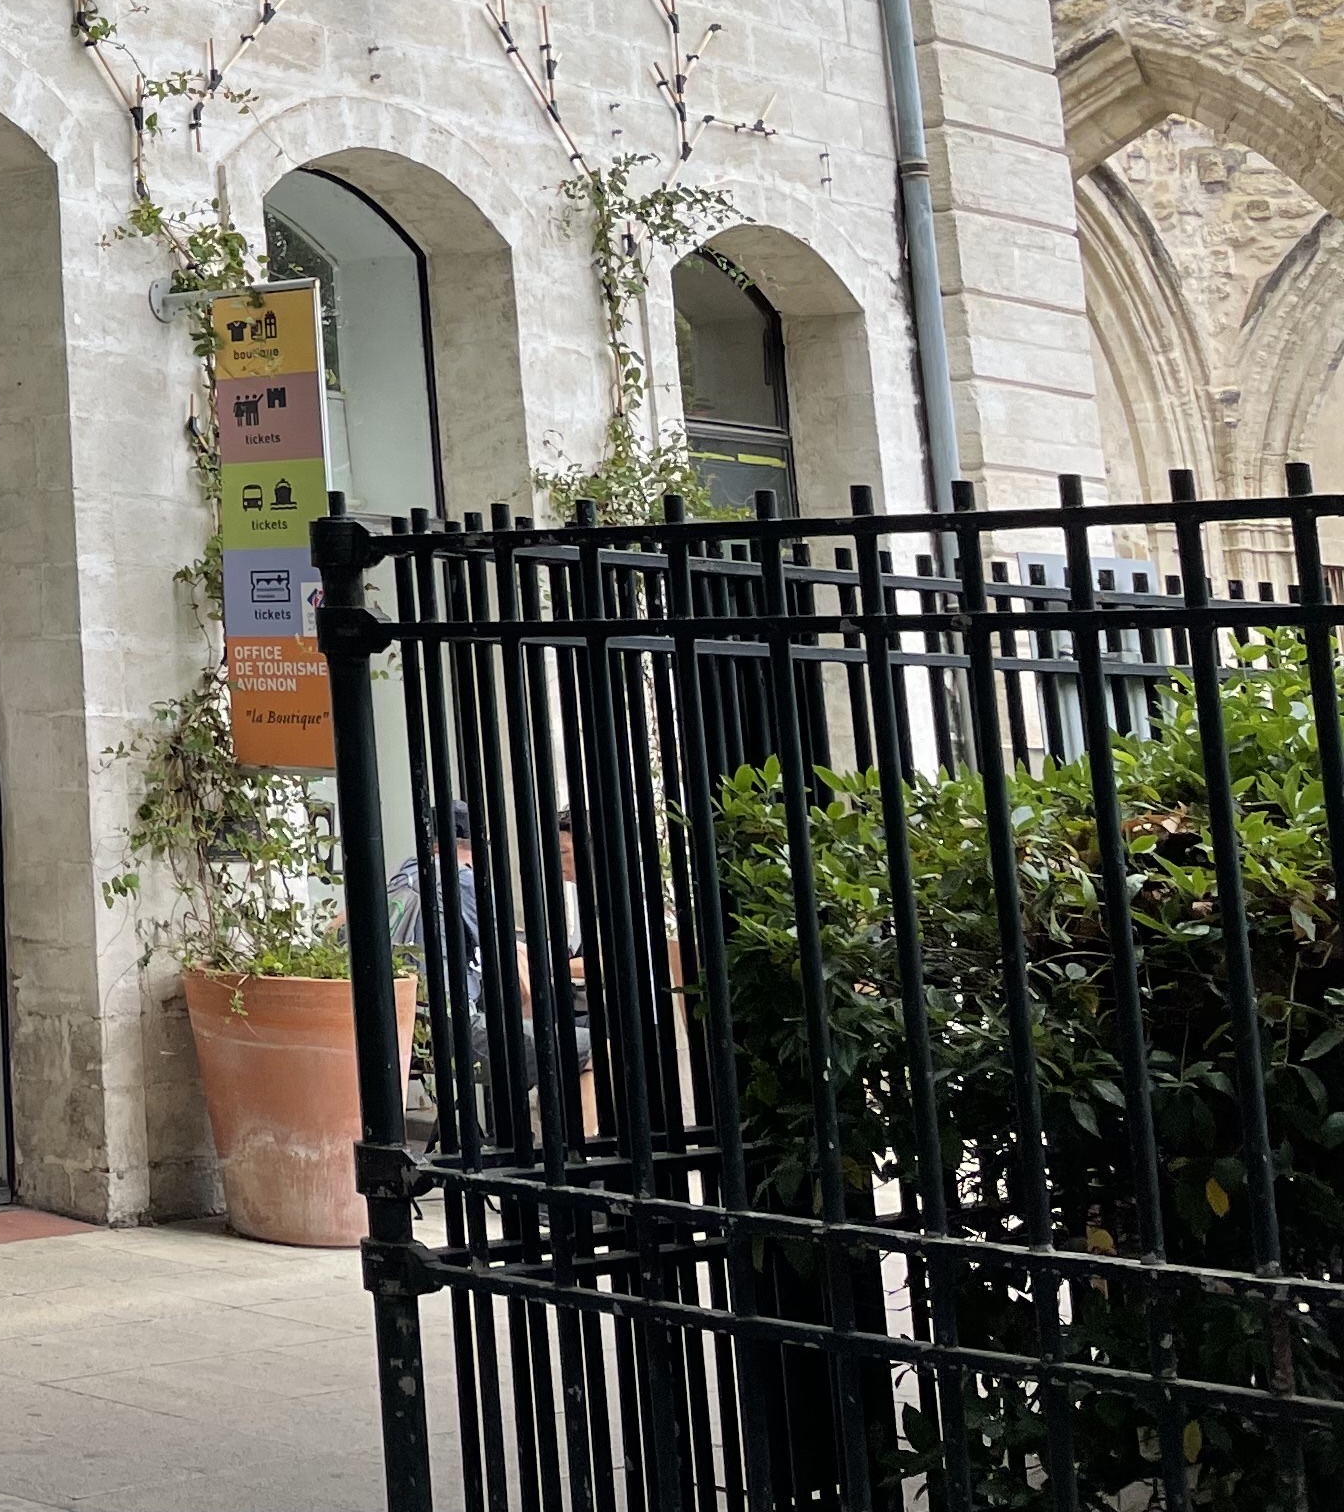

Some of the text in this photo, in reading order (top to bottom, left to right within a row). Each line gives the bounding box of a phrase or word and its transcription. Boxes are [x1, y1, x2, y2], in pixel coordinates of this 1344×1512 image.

[245, 433, 281, 445] tickets
[251, 519, 288, 531] tickets
[254, 608, 291, 620] tickets
[234, 645, 283, 660] OFFICE
[235, 661, 328, 676] DE TOURISME
[237, 677, 297, 692] AVIGNON
[246, 708, 330, 731] "la Boutique"
